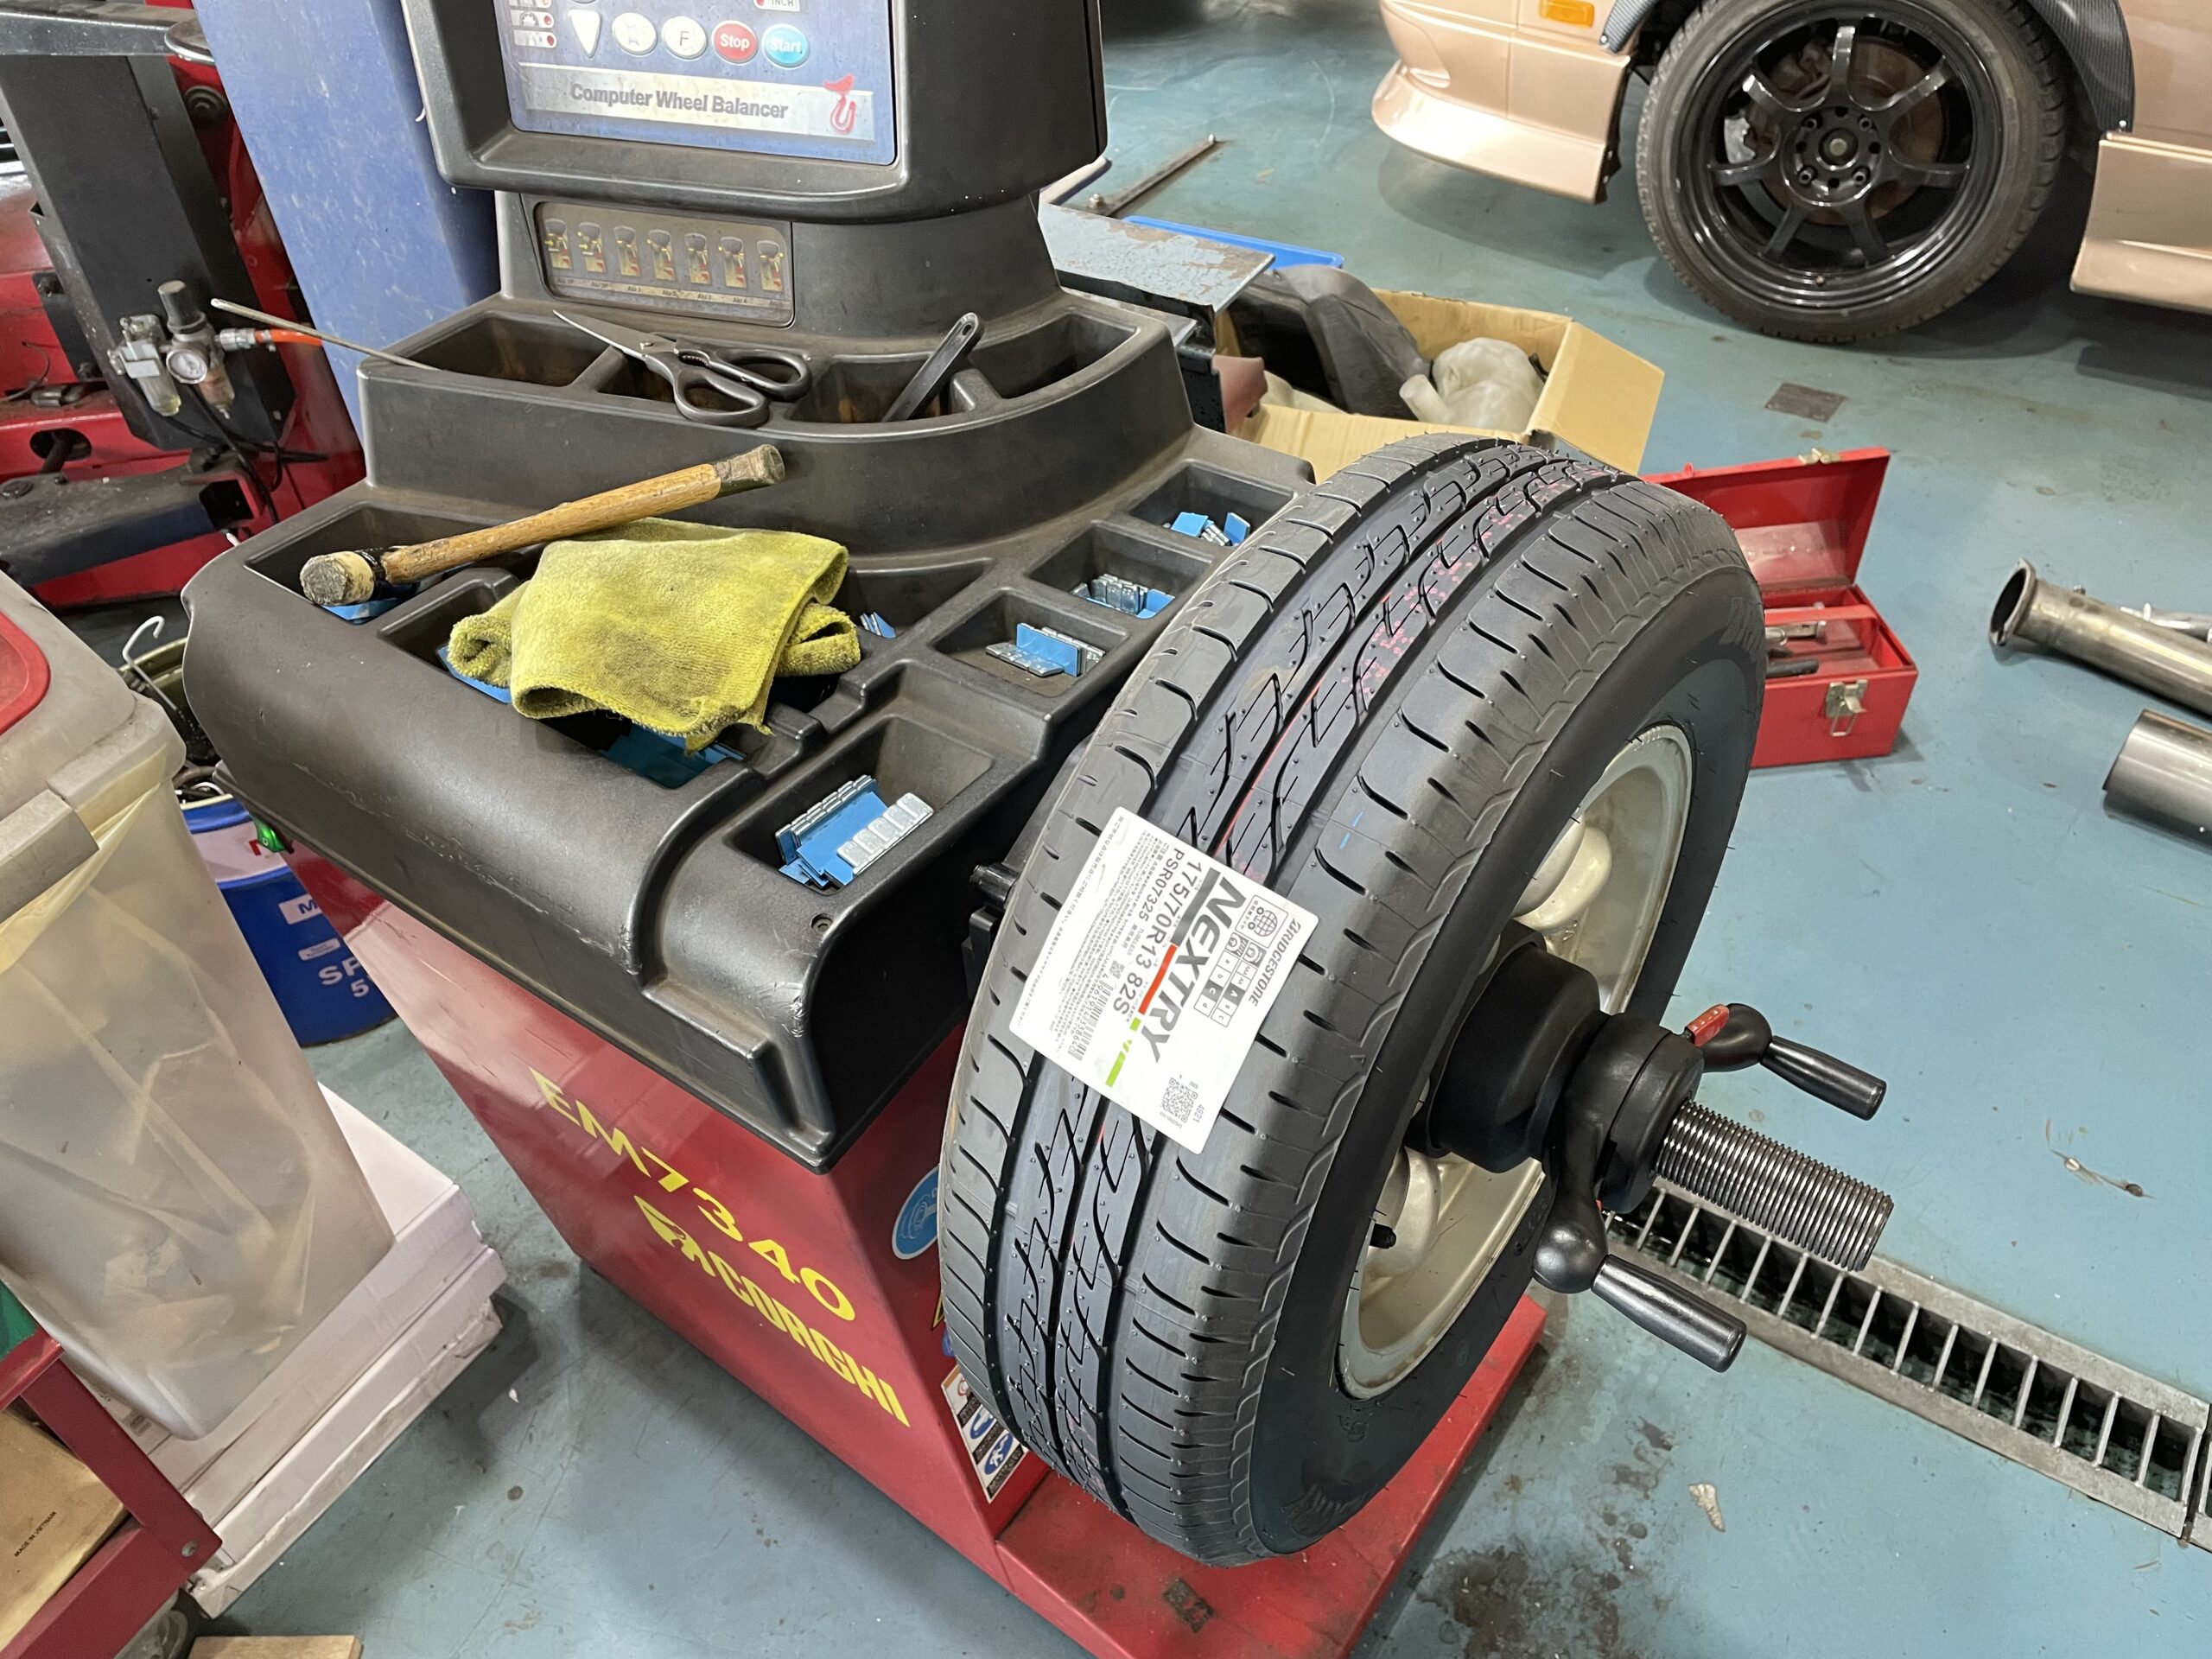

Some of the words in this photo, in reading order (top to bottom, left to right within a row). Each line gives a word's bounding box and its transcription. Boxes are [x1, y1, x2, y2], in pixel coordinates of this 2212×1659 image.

[680, 31, 690, 46] F
[720, 34, 750, 51] Stop
[770, 37, 801, 52] Start
[570, 84, 652, 107] Computer
[655, 90, 708, 111] Wheel
[711, 95, 788, 118] Balancer
[1139, 848, 1185, 921] PSR07325
[1135, 861, 1202, 969] 175/70R13
[1141, 876, 1247, 1063] NEXTRY
[1249, 918, 1301, 1007] BRIDGESTONE
[1113, 972, 1143, 1014] 82S
[1192, 1104, 1205, 1123] 4921
[529, 1066, 855, 1321] EM7340
[708, 1251, 910, 1427] CORGHI
[14, 1541, 30, 1557] MADE
[34, 1511, 57, 1535] VIETNAM
